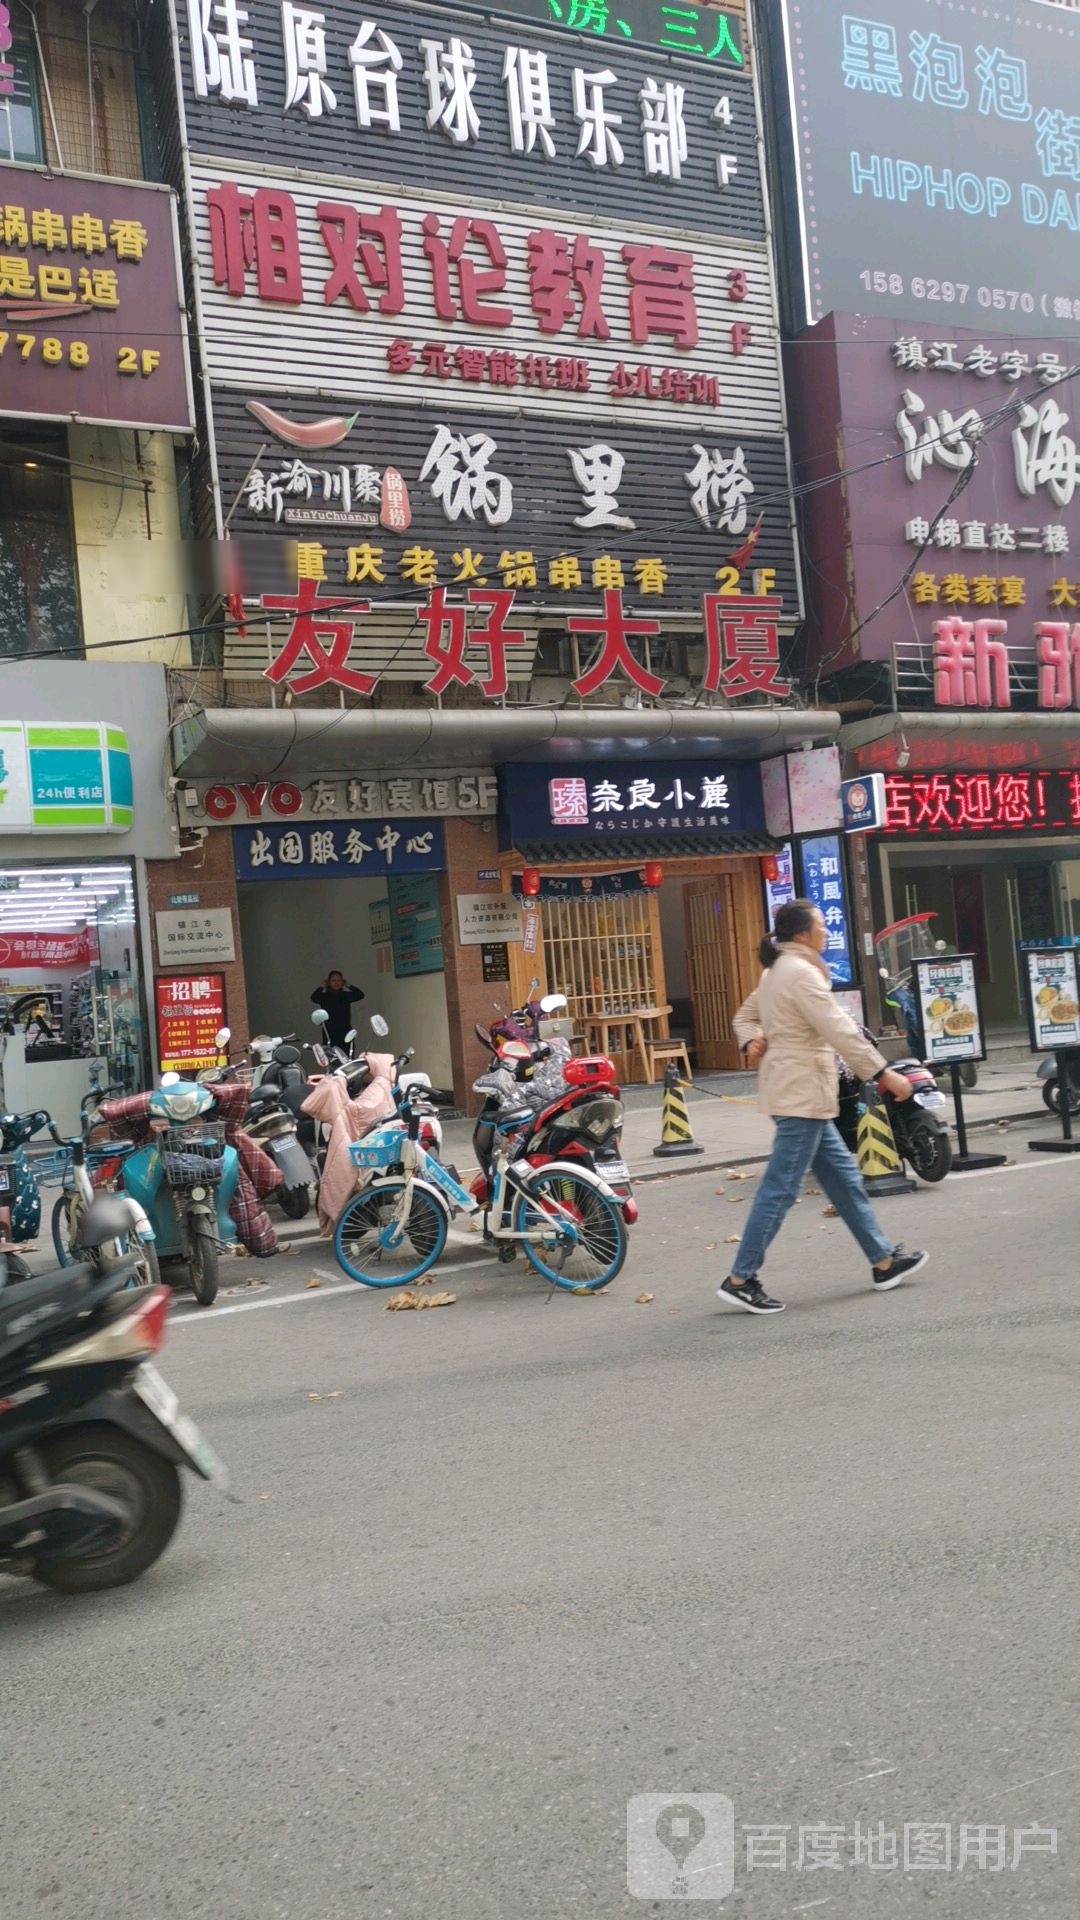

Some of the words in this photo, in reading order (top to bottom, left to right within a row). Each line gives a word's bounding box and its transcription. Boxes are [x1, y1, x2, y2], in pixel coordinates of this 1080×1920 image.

[188, 0, 688, 180] 陆原台球俱乐部
[841, 15, 1033, 121] 黑泡泡
[850, 152, 1011, 217] HIPHOP
[1021, 183, 1080, 231] DA
[0, 256, 120, 308] 是巴适
[206, 181, 701, 350] 相对论教育
[859, 269, 903, 295] 158
[911, 276, 970, 303] 6297
[977, 286, 1035, 313] 0570
[117, 346, 161, 375] 2F
[387, 339, 590, 392] 多元智能托班
[608, 362, 720, 407] 少儿培训
[892, 336, 1068, 385] 镇江老字号
[419, 423, 756, 535] 锅里捞
[287, 510, 378, 523] XinYuChuanJu
[905, 516, 1070, 553] 电梯直达二楼
[297, 542, 668, 594] 重庆老火锅串串香
[715, 566, 777, 596] 2F
[913, 571, 1027, 606] 各类家宴
[1048, 577, 1080, 607] 大
[261, 576, 792, 700] 友好大厦
[37, 786, 103, 799] 24h便利店
[203, 781, 303, 820] OYO
[249, 824, 434, 867] 出国服务中心
[171, 980, 211, 1001] 招聘
